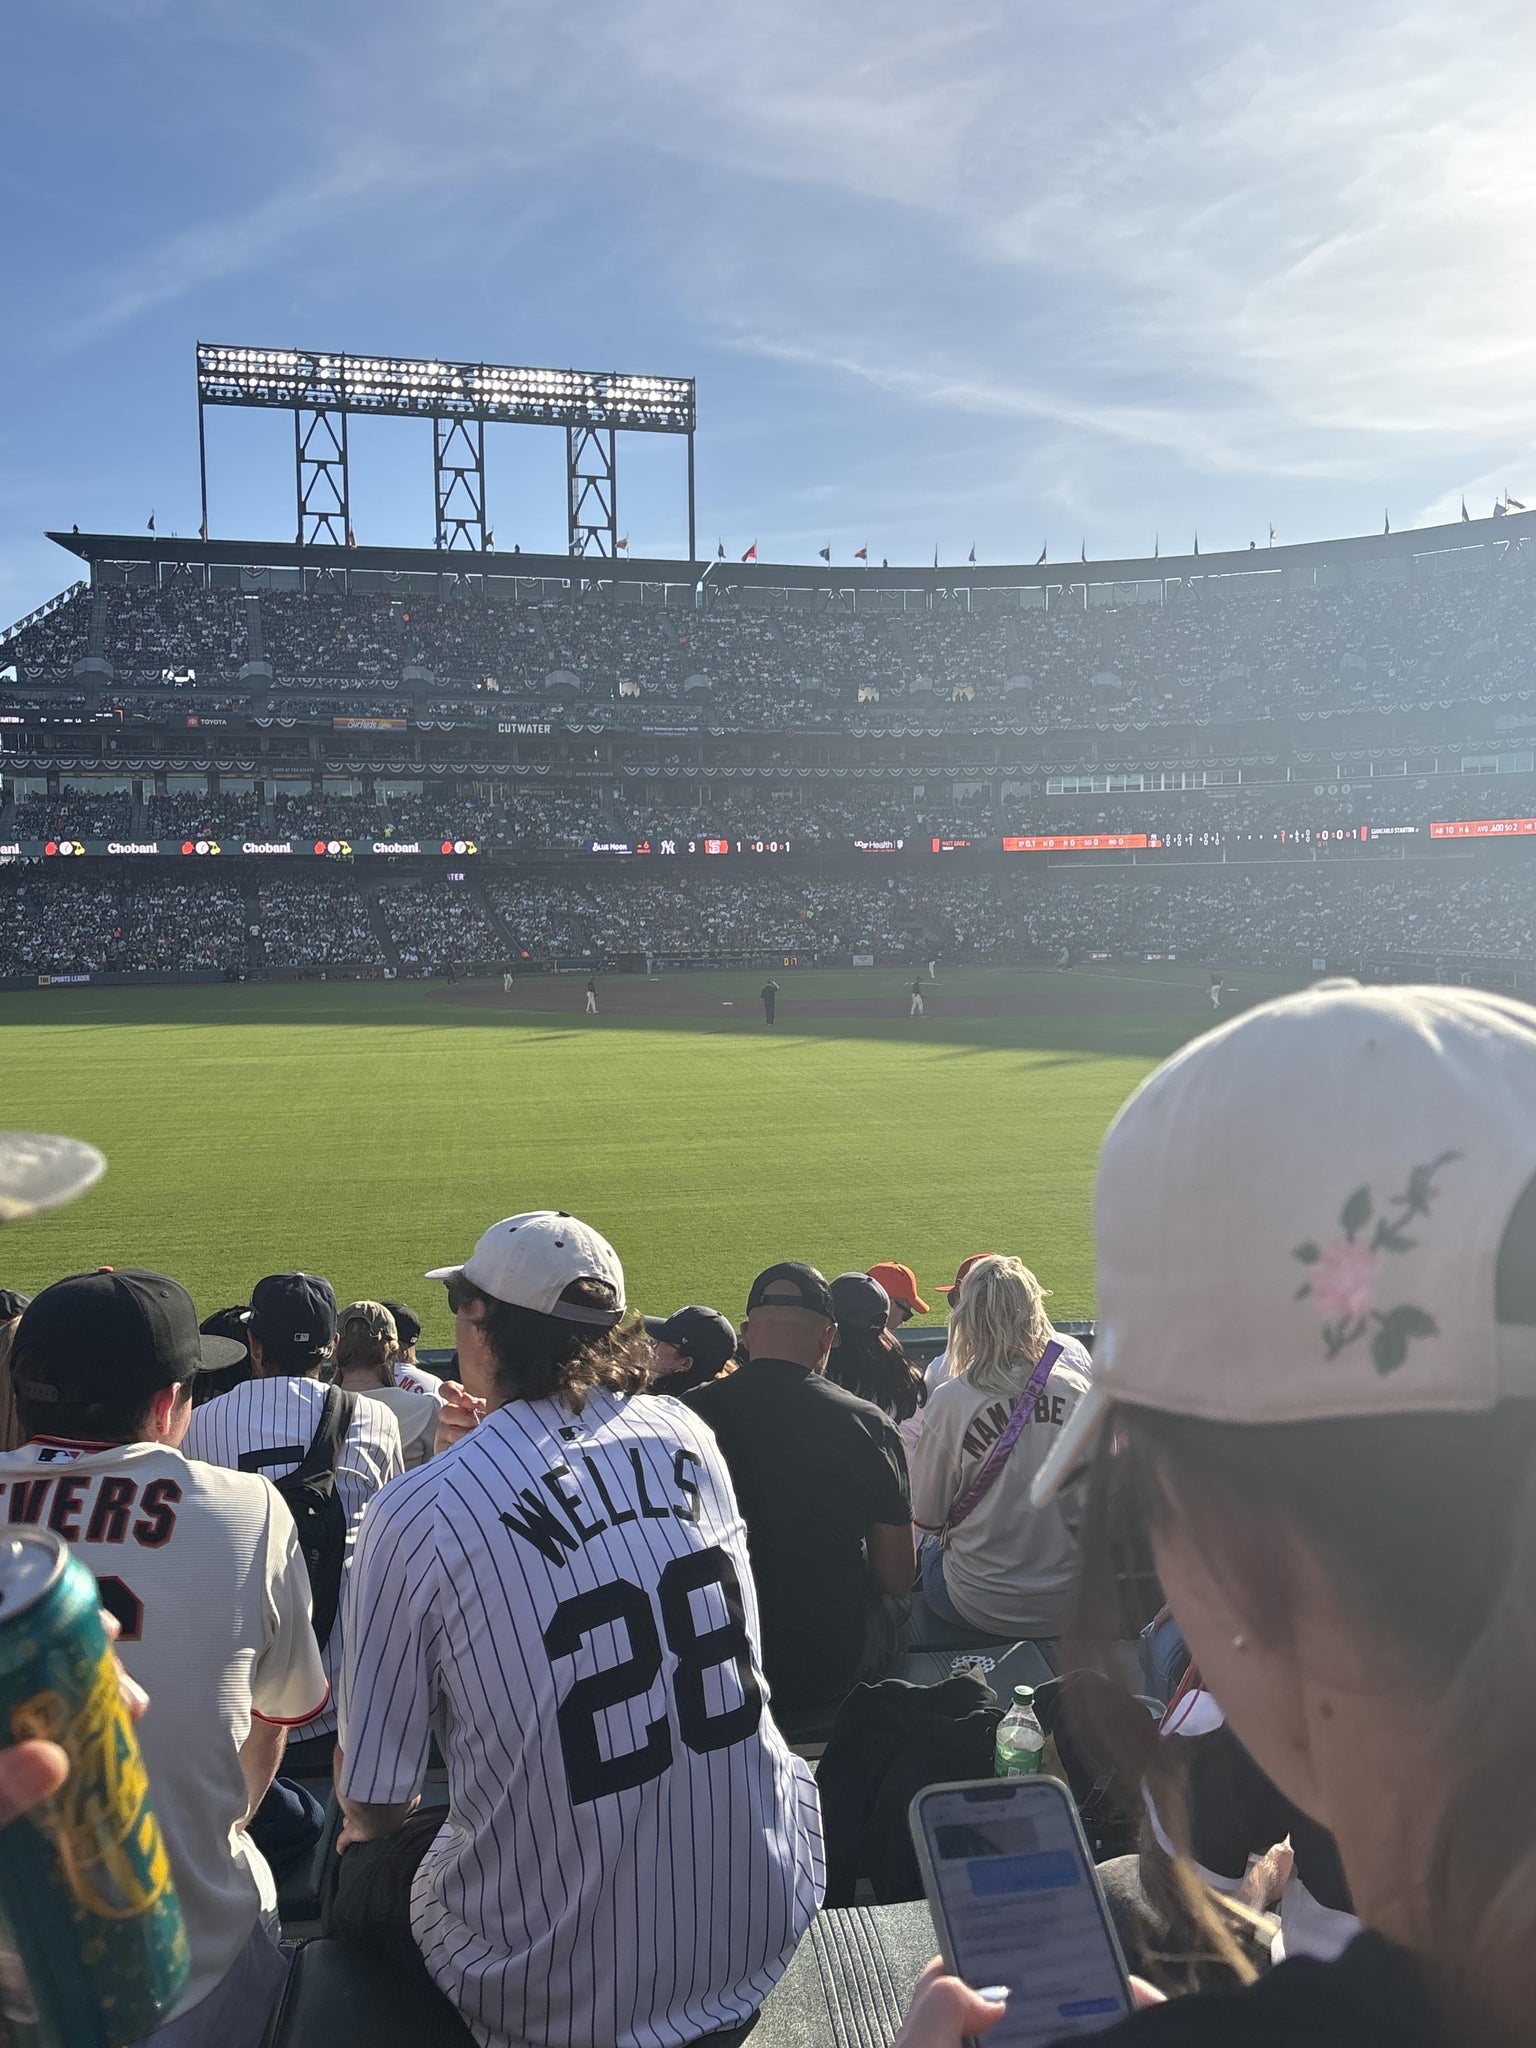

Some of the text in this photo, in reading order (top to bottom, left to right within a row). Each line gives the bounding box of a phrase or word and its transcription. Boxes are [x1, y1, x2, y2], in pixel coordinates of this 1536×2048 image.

[498, 723, 551, 734] CUTWATER
[1464, 825, 1469, 833] 6
[1512, 823, 1518, 831] 2
[1321, 830, 1329, 840] 0
[1336, 830, 1343, 840] 0
[1352, 829, 1357, 839] 1
[643, 841, 650, 849] 6
[688, 841, 695, 853] 3
[736, 841, 741, 853] 1
[756, 841, 763, 853] 0
[770, 841, 777, 853] 0
[785, 841, 790, 853] 1
[869, 840, 893, 849] Health
[0, 1476, 183, 1549] VERS
[498, 1448, 701, 1568] WELLS
[543, 1545, 762, 1806] 28
